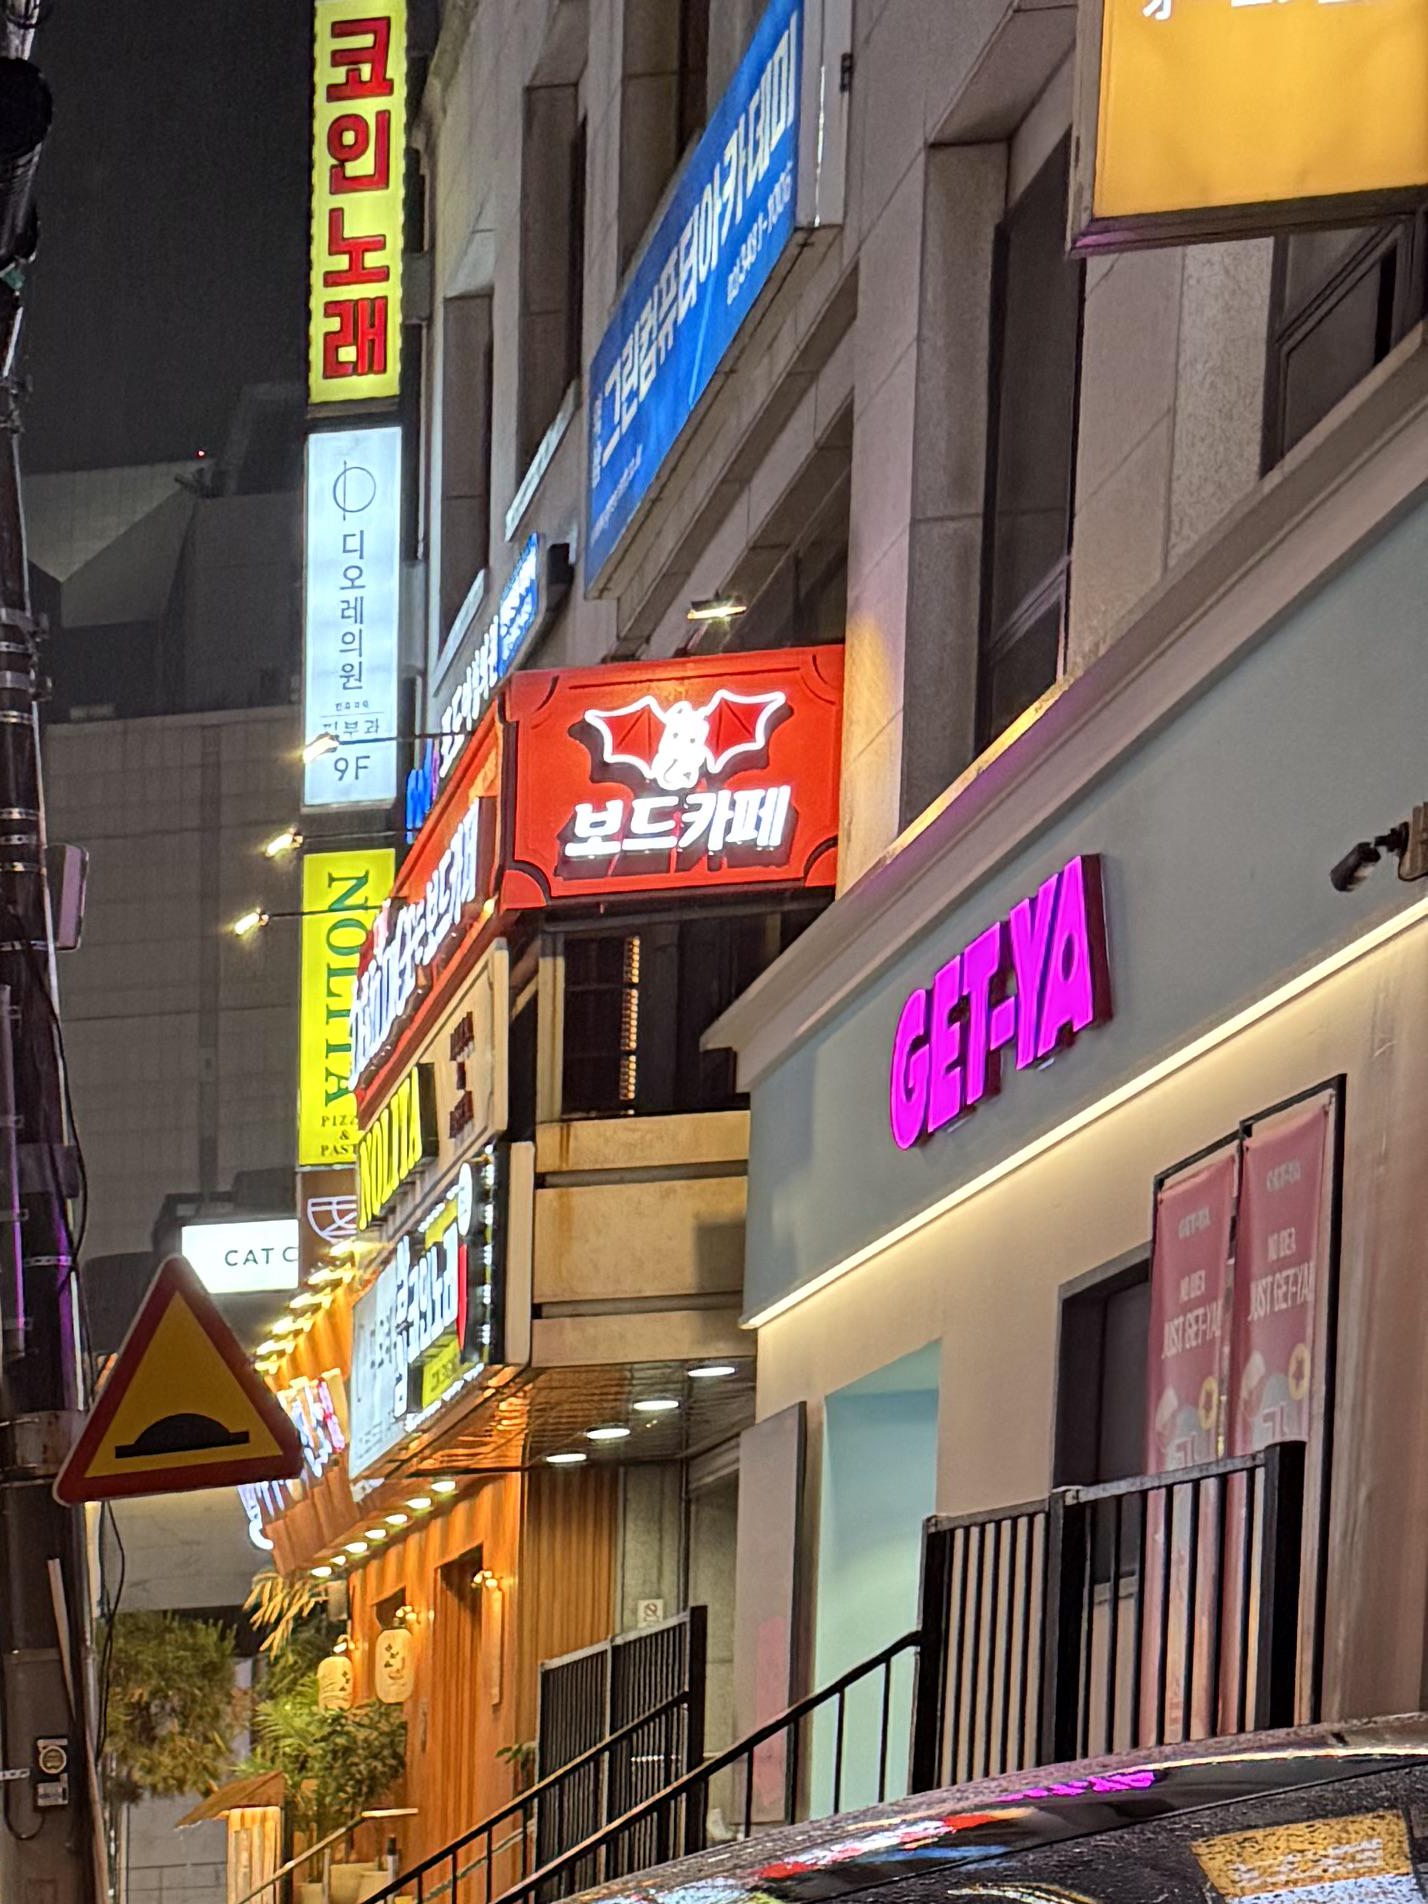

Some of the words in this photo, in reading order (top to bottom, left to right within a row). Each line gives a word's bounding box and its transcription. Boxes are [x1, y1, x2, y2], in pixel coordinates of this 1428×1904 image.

[322, 15, 395, 381] 코인노래
[601, 10, 799, 468] 그린컴퓨터아카데미
[339, 530, 366, 691] 디오레의원
[334, 756, 371, 782] 9F
[564, 783, 790, 860] 보드카페
[324, 869, 371, 1110] NOLITA
[890, 855, 1093, 1150] GET-YA
[319, 1142, 358, 1156] PAST
[320, 1114, 358, 1128] PIZZ
[358, 1065, 423, 1231] NOLITA
[224, 1247, 277, 1268] CAT
